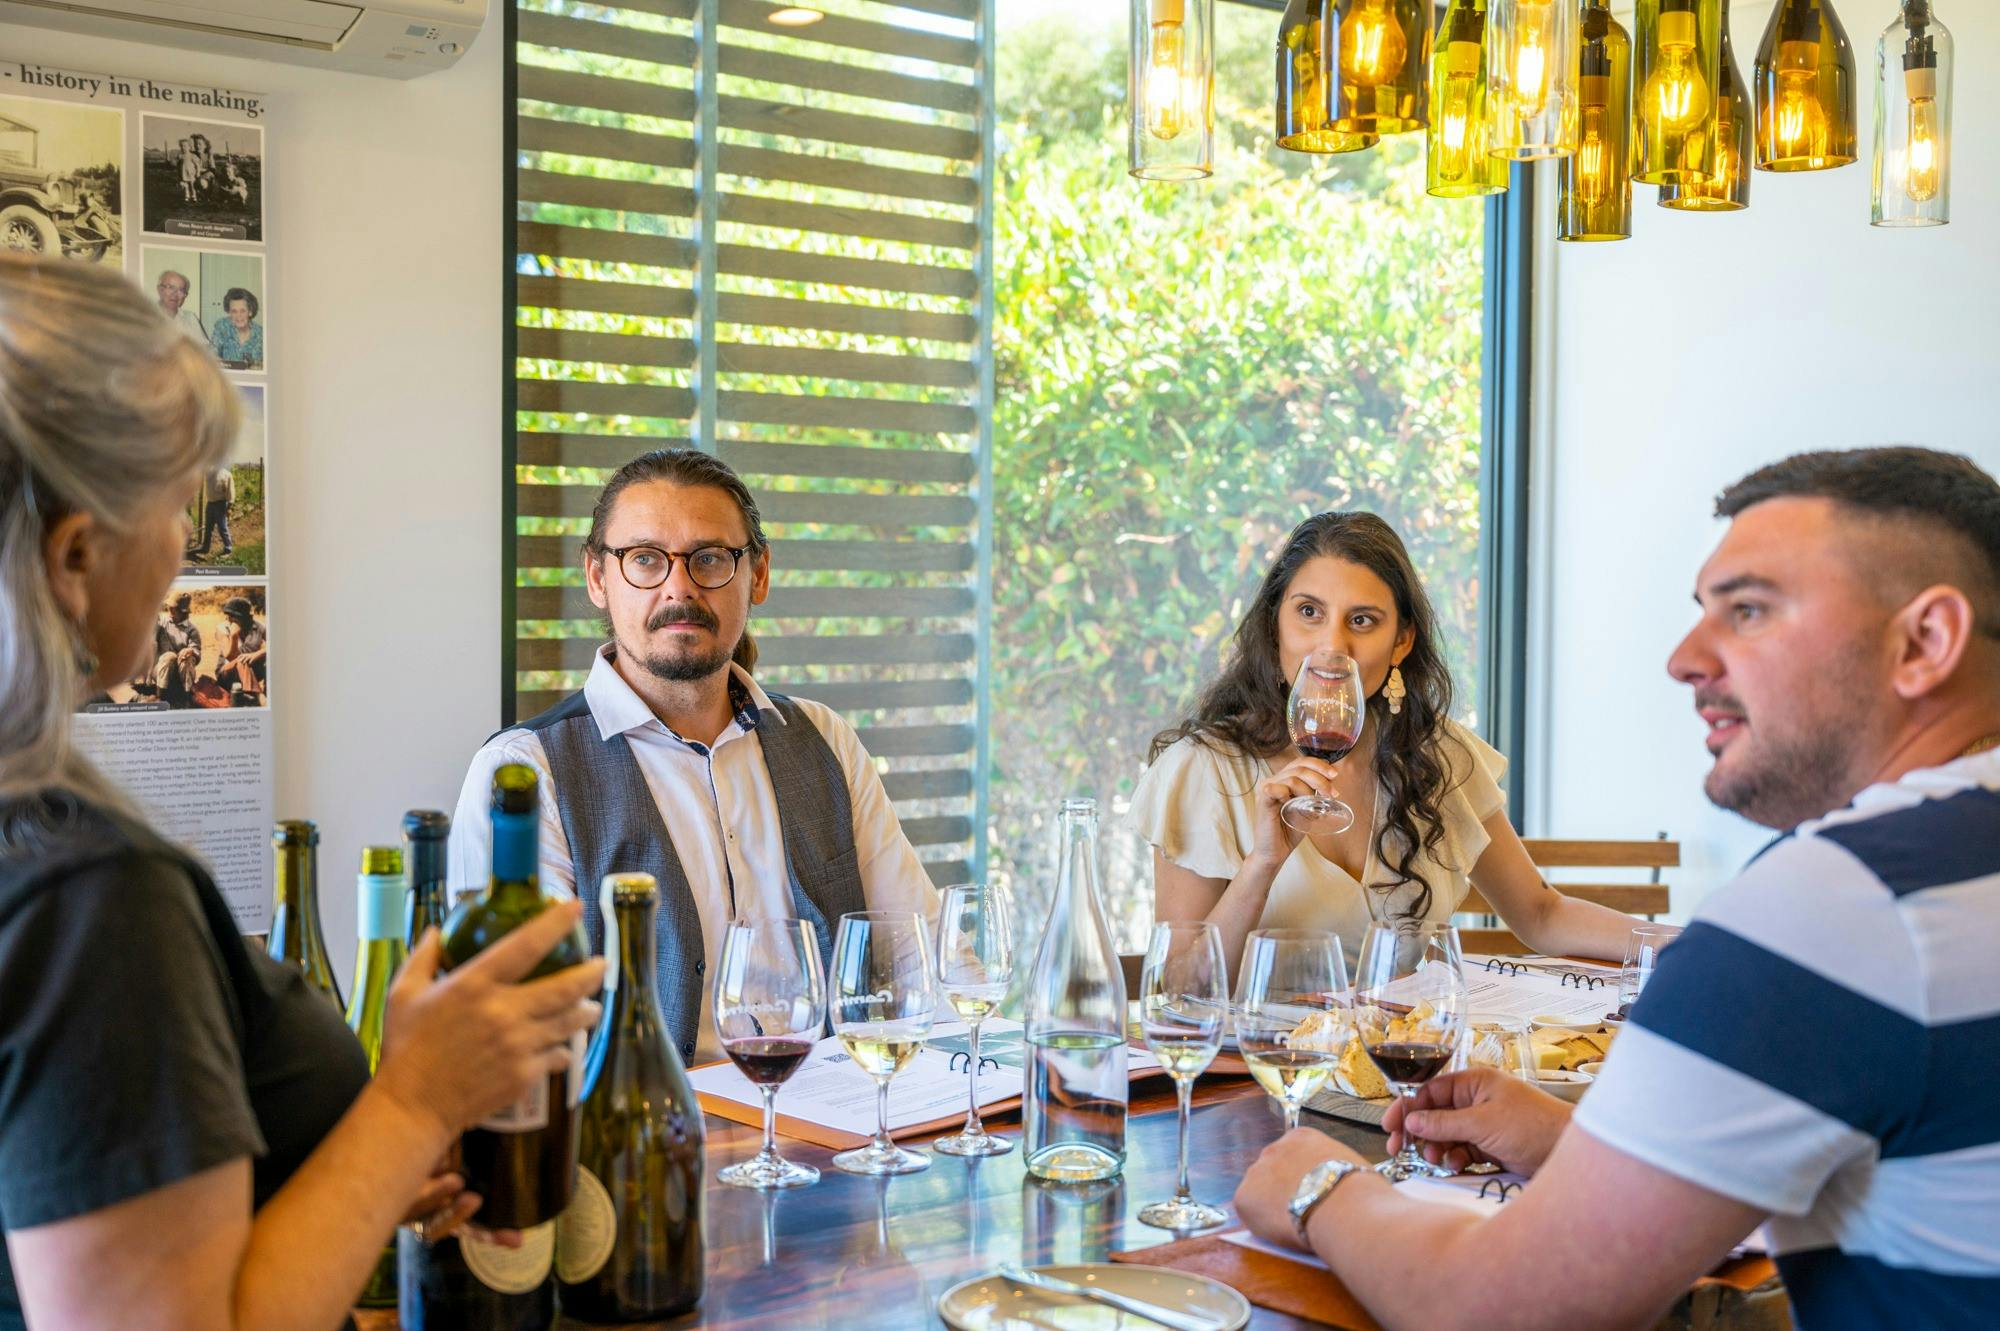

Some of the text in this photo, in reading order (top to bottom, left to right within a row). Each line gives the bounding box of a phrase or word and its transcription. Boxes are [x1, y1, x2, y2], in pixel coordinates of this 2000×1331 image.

[20, 63, 101, 98] history
[109, 75, 131, 96] in
[139, 80, 173, 101] the
[180, 88, 265, 119] making.
